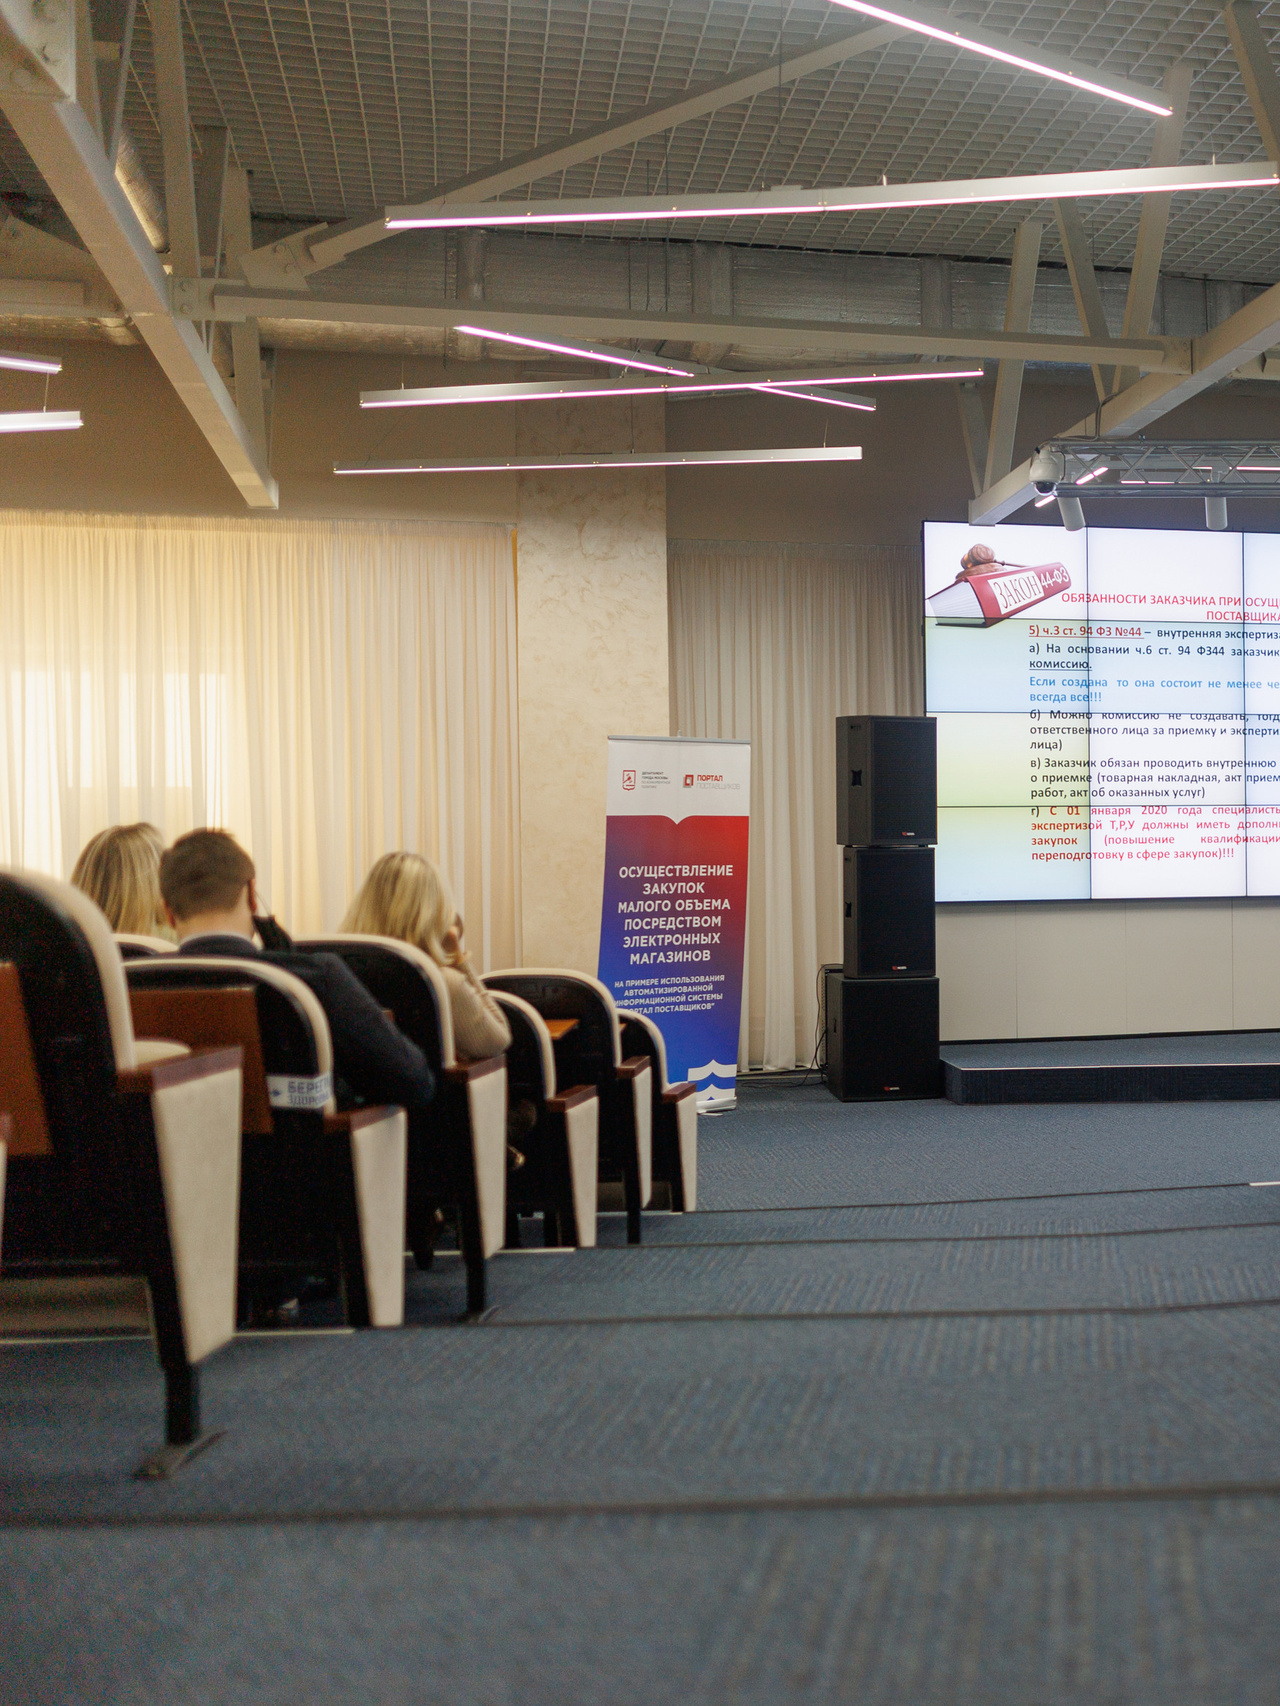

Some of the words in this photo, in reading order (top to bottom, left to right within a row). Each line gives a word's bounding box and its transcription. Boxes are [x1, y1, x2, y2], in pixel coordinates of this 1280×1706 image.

[994, 576, 1041, 608] ЗАКОН
[1040, 566, 1069, 588] 44-ФЗ
[1062, 593, 1146, 604] ОБЯЗАННОСТИ
[1151, 595, 1216, 606] ЗАКАЗЧИКА
[1219, 597, 1241, 606] ПРИ
[1029, 625, 1039, 636] 5)
[1043, 626, 1059, 635] ч.3
[1080, 626, 1093, 636] 94
[1096, 627, 1111, 636] ФЗ
[1116, 628, 1141, 636] №44
[1158, 630, 1221, 639] внутренняя
[1029, 644, 1039, 655] а)
[1047, 644, 1060, 654] На
[1068, 646, 1129, 654] основании
[1136, 645, 1152, 655] ч.6
[1178, 646, 1190, 655] 94
[1231, 648, 1279, 657] заказчик
[1030, 677, 1055, 686] Если
[1062, 678, 1107, 688] создана
[1030, 694, 1066, 703] всегда
[1070, 692, 1101, 702] все!!!
[1030, 710, 1040, 721] б)
[1030, 726, 1118, 735] ответственного
[1122, 727, 1149, 736] лица
[1168, 727, 1216, 736] приемку
[1030, 739, 1062, 750] лица)
[1031, 758, 1040, 769] в)
[1045, 759, 1096, 768] Заказчик
[1100, 758, 1139, 768] обязан
[1144, 760, 1202, 769] проводить
[1206, 760, 1276, 769] внутреннюю
[1042, 775, 1092, 784] приемке
[1097, 773, 1153, 784] (товарная
[1158, 774, 1220, 784] накладная,
[1031, 788, 1067, 799] работ,
[1091, 787, 1105, 797] об
[1173, 788, 1205, 799] услуг)
[1032, 806, 1039, 817] г)
[1067, 806, 1080, 815] 01
[1091, 807, 1131, 816] января
[1141, 806, 1167, 814] 2020
[1178, 807, 1201, 816] года
[1032, 821, 1102, 832] экспертизой
[1110, 820, 1134, 831] Т,Р,У
[1142, 821, 1188, 830] должны
[1032, 837, 1077, 847] закупок
[1104, 834, 1174, 846] (повышение
[1032, 851, 1124, 862] переподготовку
[1137, 849, 1170, 860] сфере
[1174, 848, 1234, 860] закупок)!!!
[619, 865, 733, 878] ОСУЩЕСТВЛЕНИЕ
[643, 882, 705, 894] ЗАКУПОК
[618, 901, 671, 913] МАЛОГО
[676, 899, 730, 911] ОБЪЕМА
[624, 916, 721, 930] ПОСРЕДСТВОМ
[623, 933, 720, 948] ЭЛЕКТРОННЫХ
[630, 950, 711, 965] МАГАЗИНОВ
[661, 975, 724, 985] ИСПОЛЬЗОВАНИЯ
[624, 983, 713, 996] АВТОМАТИЗИРОВАННОЙ
